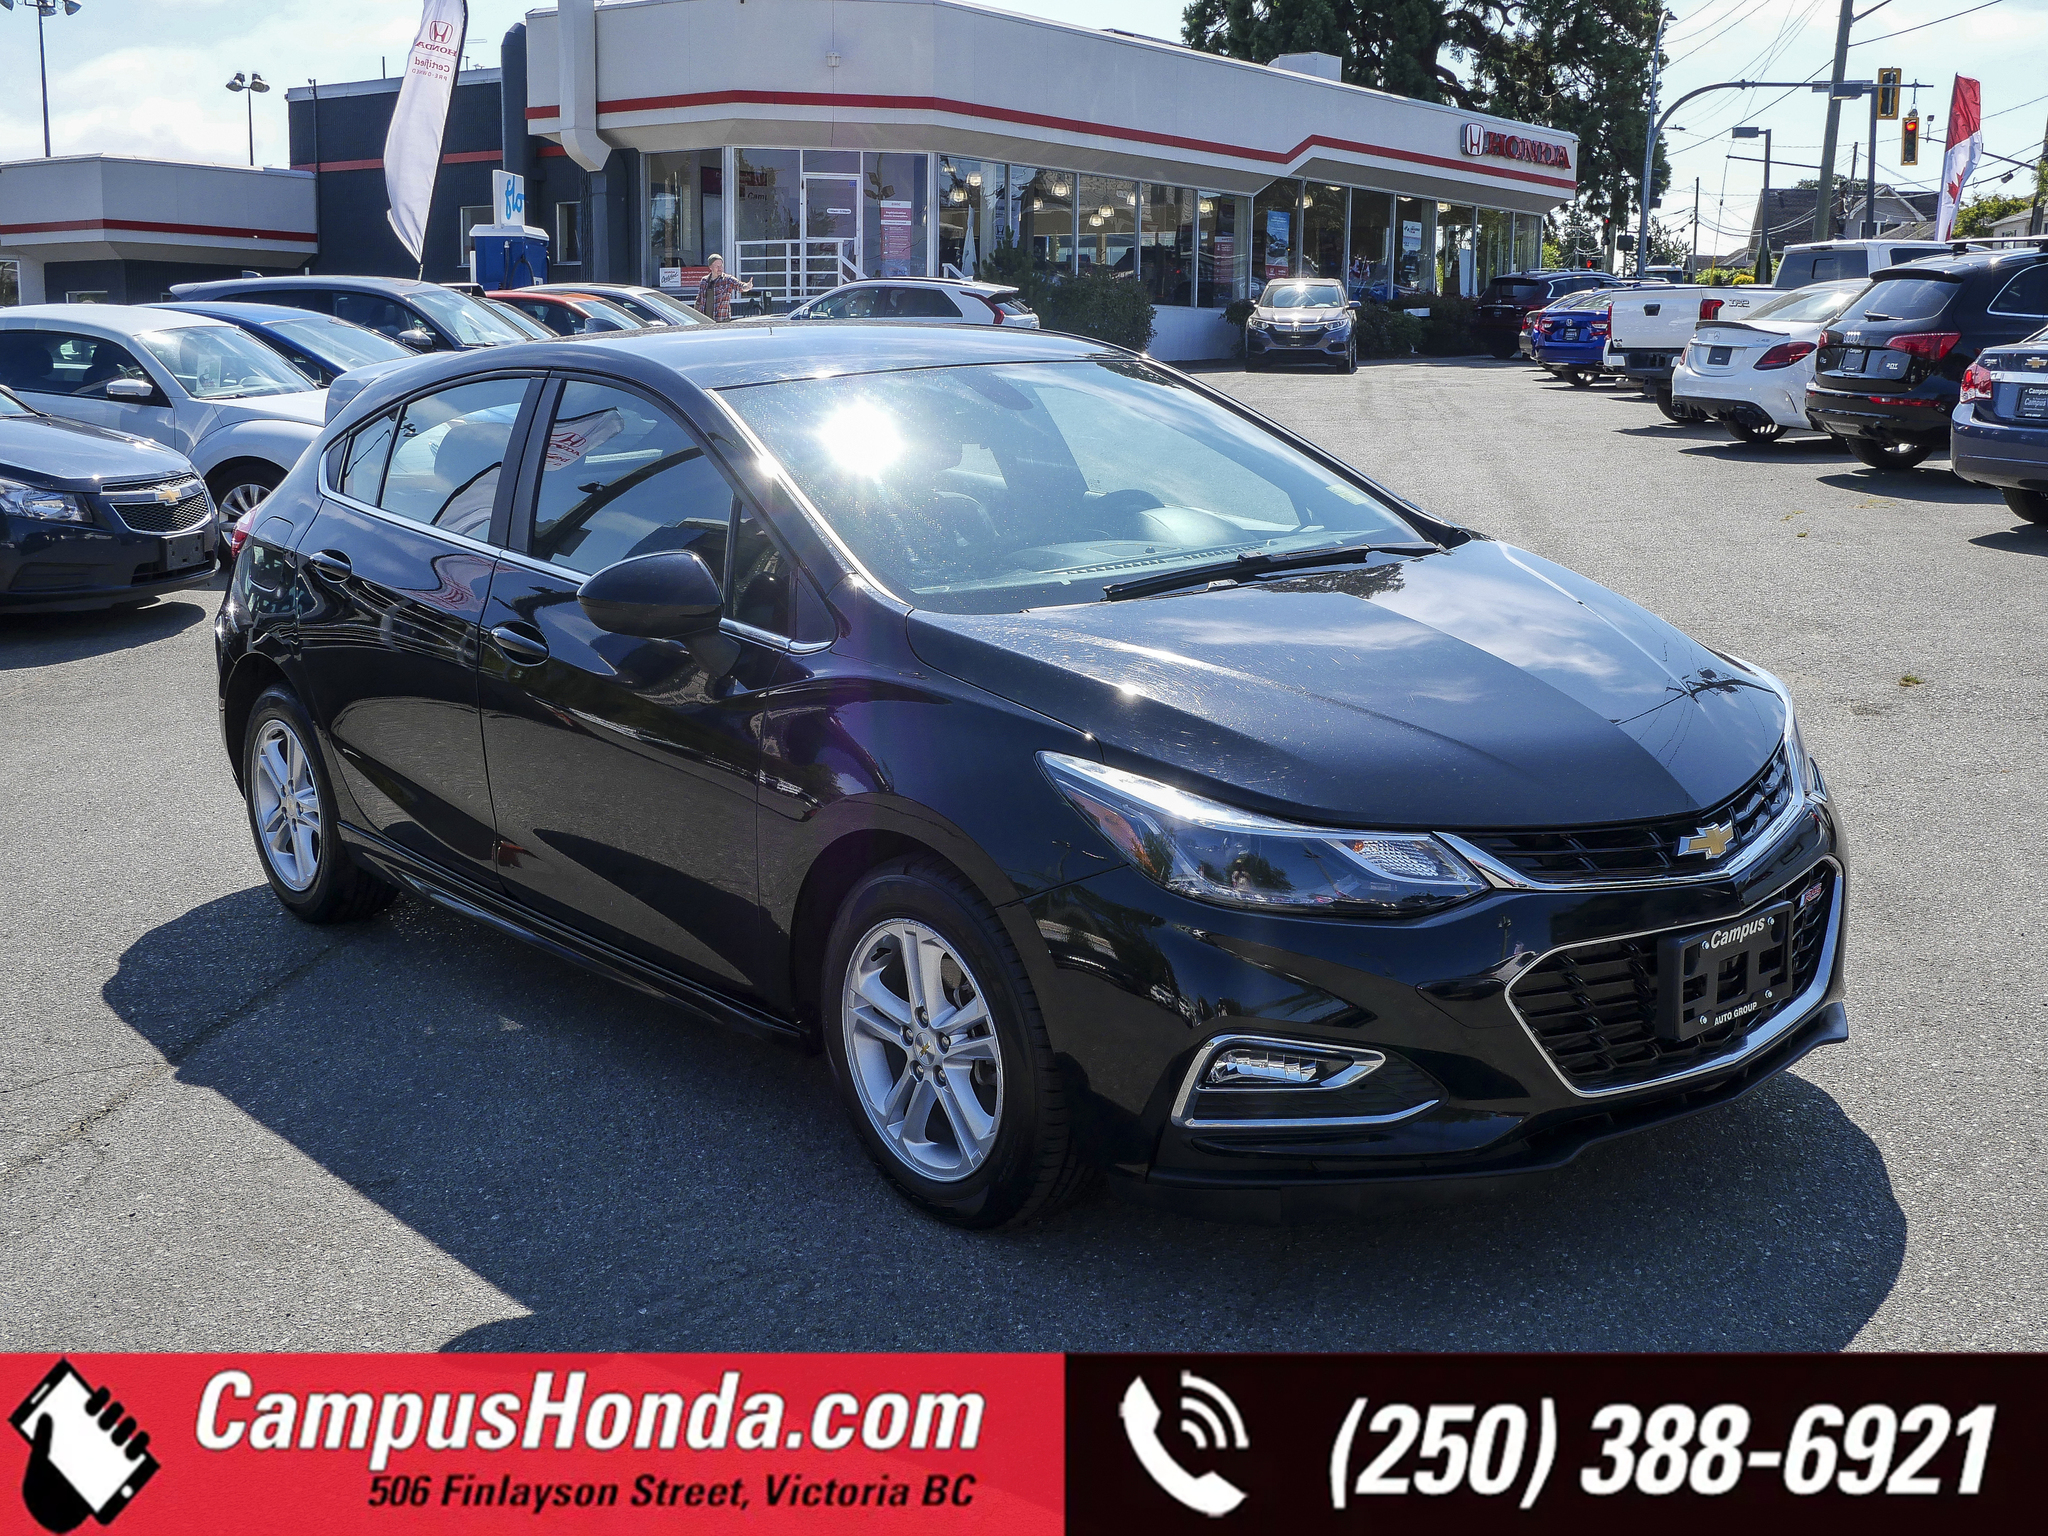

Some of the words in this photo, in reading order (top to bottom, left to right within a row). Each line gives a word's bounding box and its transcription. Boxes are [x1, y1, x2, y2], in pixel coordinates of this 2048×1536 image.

[1486, 131, 1572, 170] HONDA
[505, 175, 524, 220] flo
[1801, 882, 1822, 907] RS
[1710, 917, 1766, 949] Campus
[1713, 1011, 1733, 1027] AUTO
[1733, 1001, 1758, 1018] GROUP
